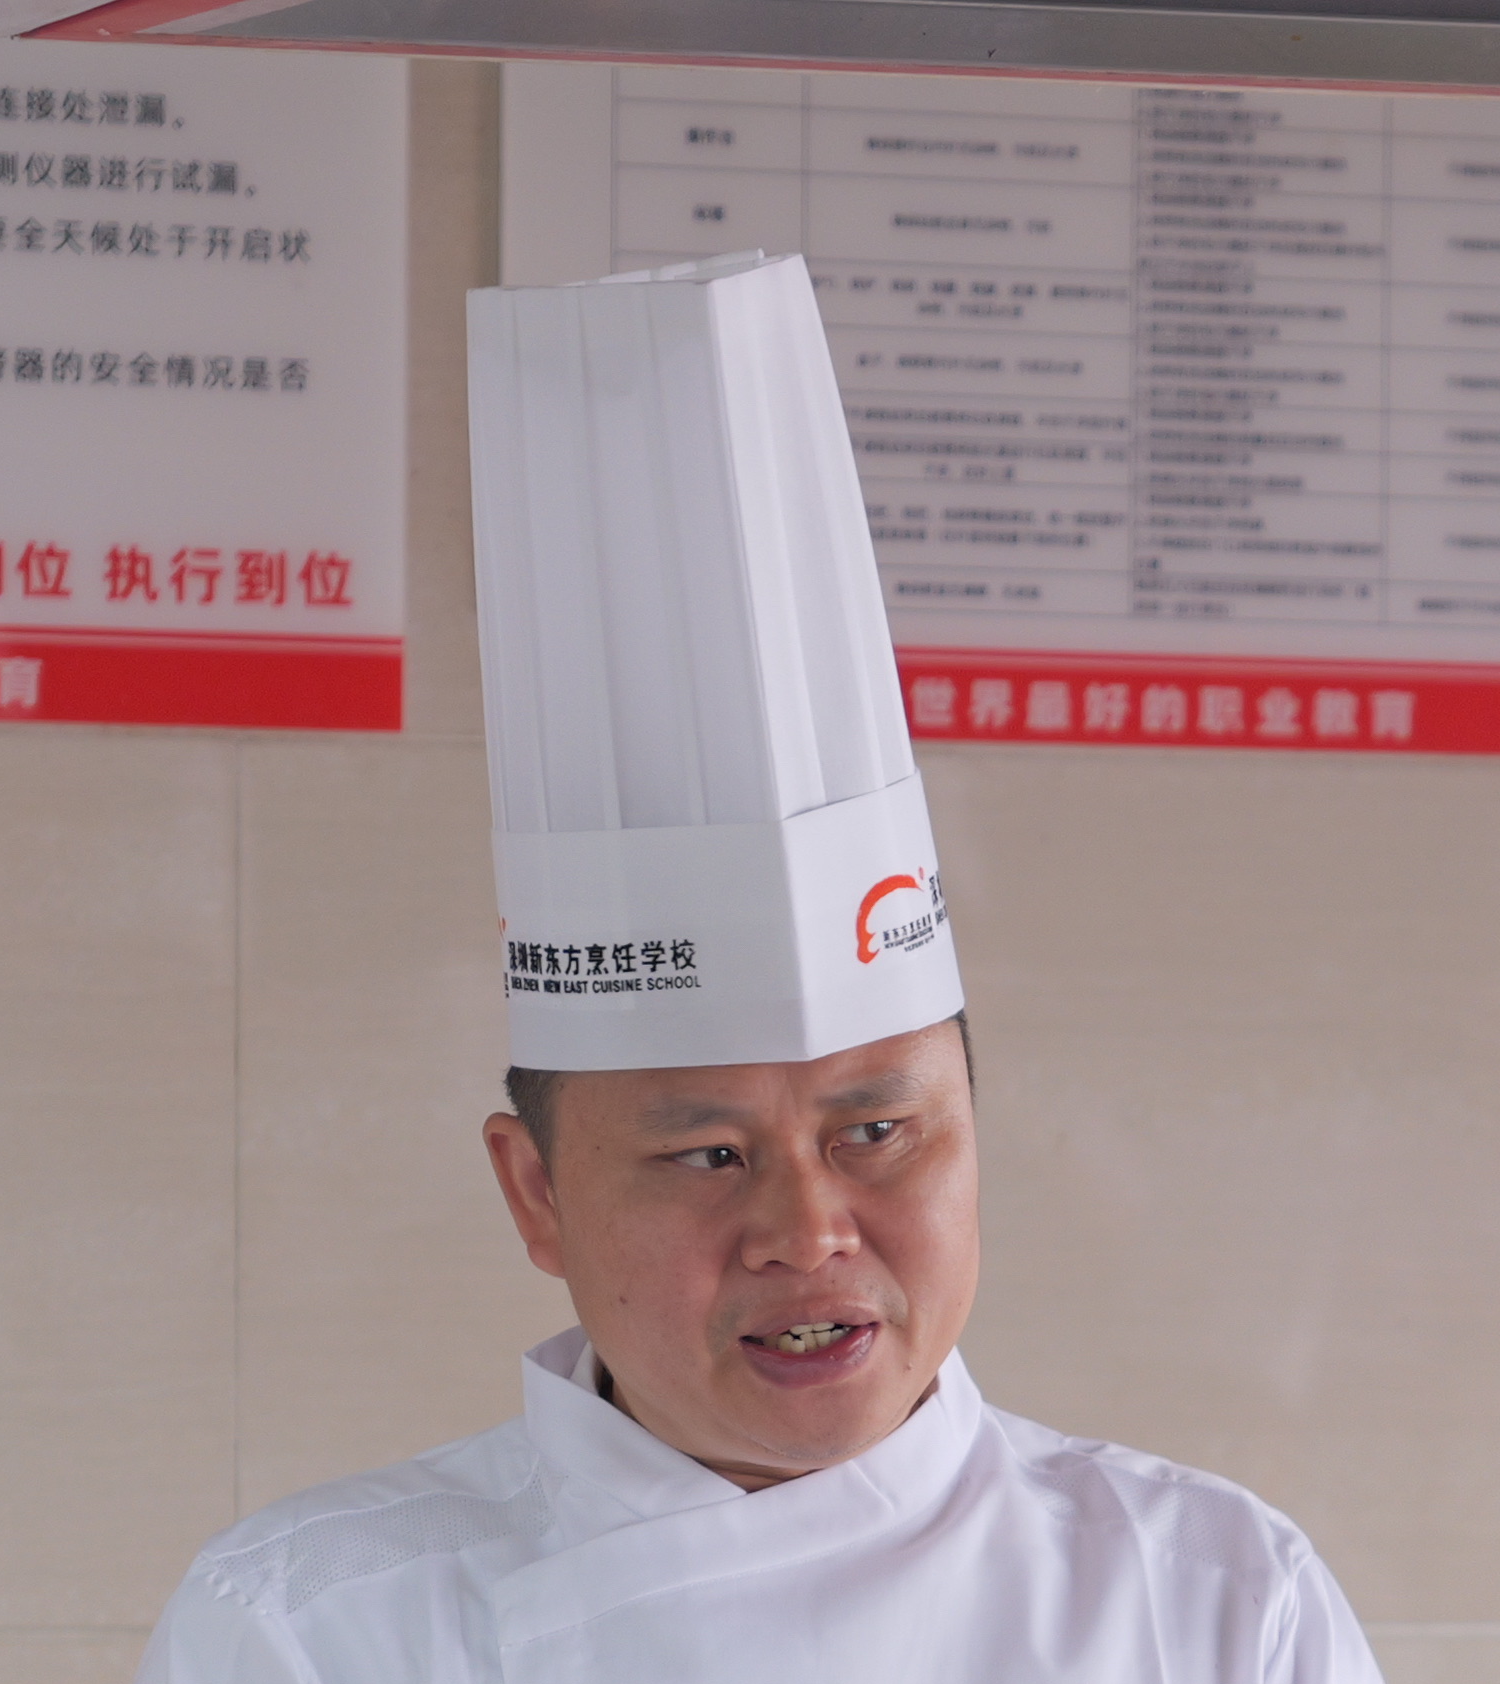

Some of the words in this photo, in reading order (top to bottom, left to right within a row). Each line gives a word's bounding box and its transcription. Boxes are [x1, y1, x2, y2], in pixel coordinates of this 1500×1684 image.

[103, 545, 354, 607] 执行到位
[564, 980, 588, 993] EAST
[592, 978, 642, 993] CUISINE
[647, 975, 701, 991] SCHOOL
